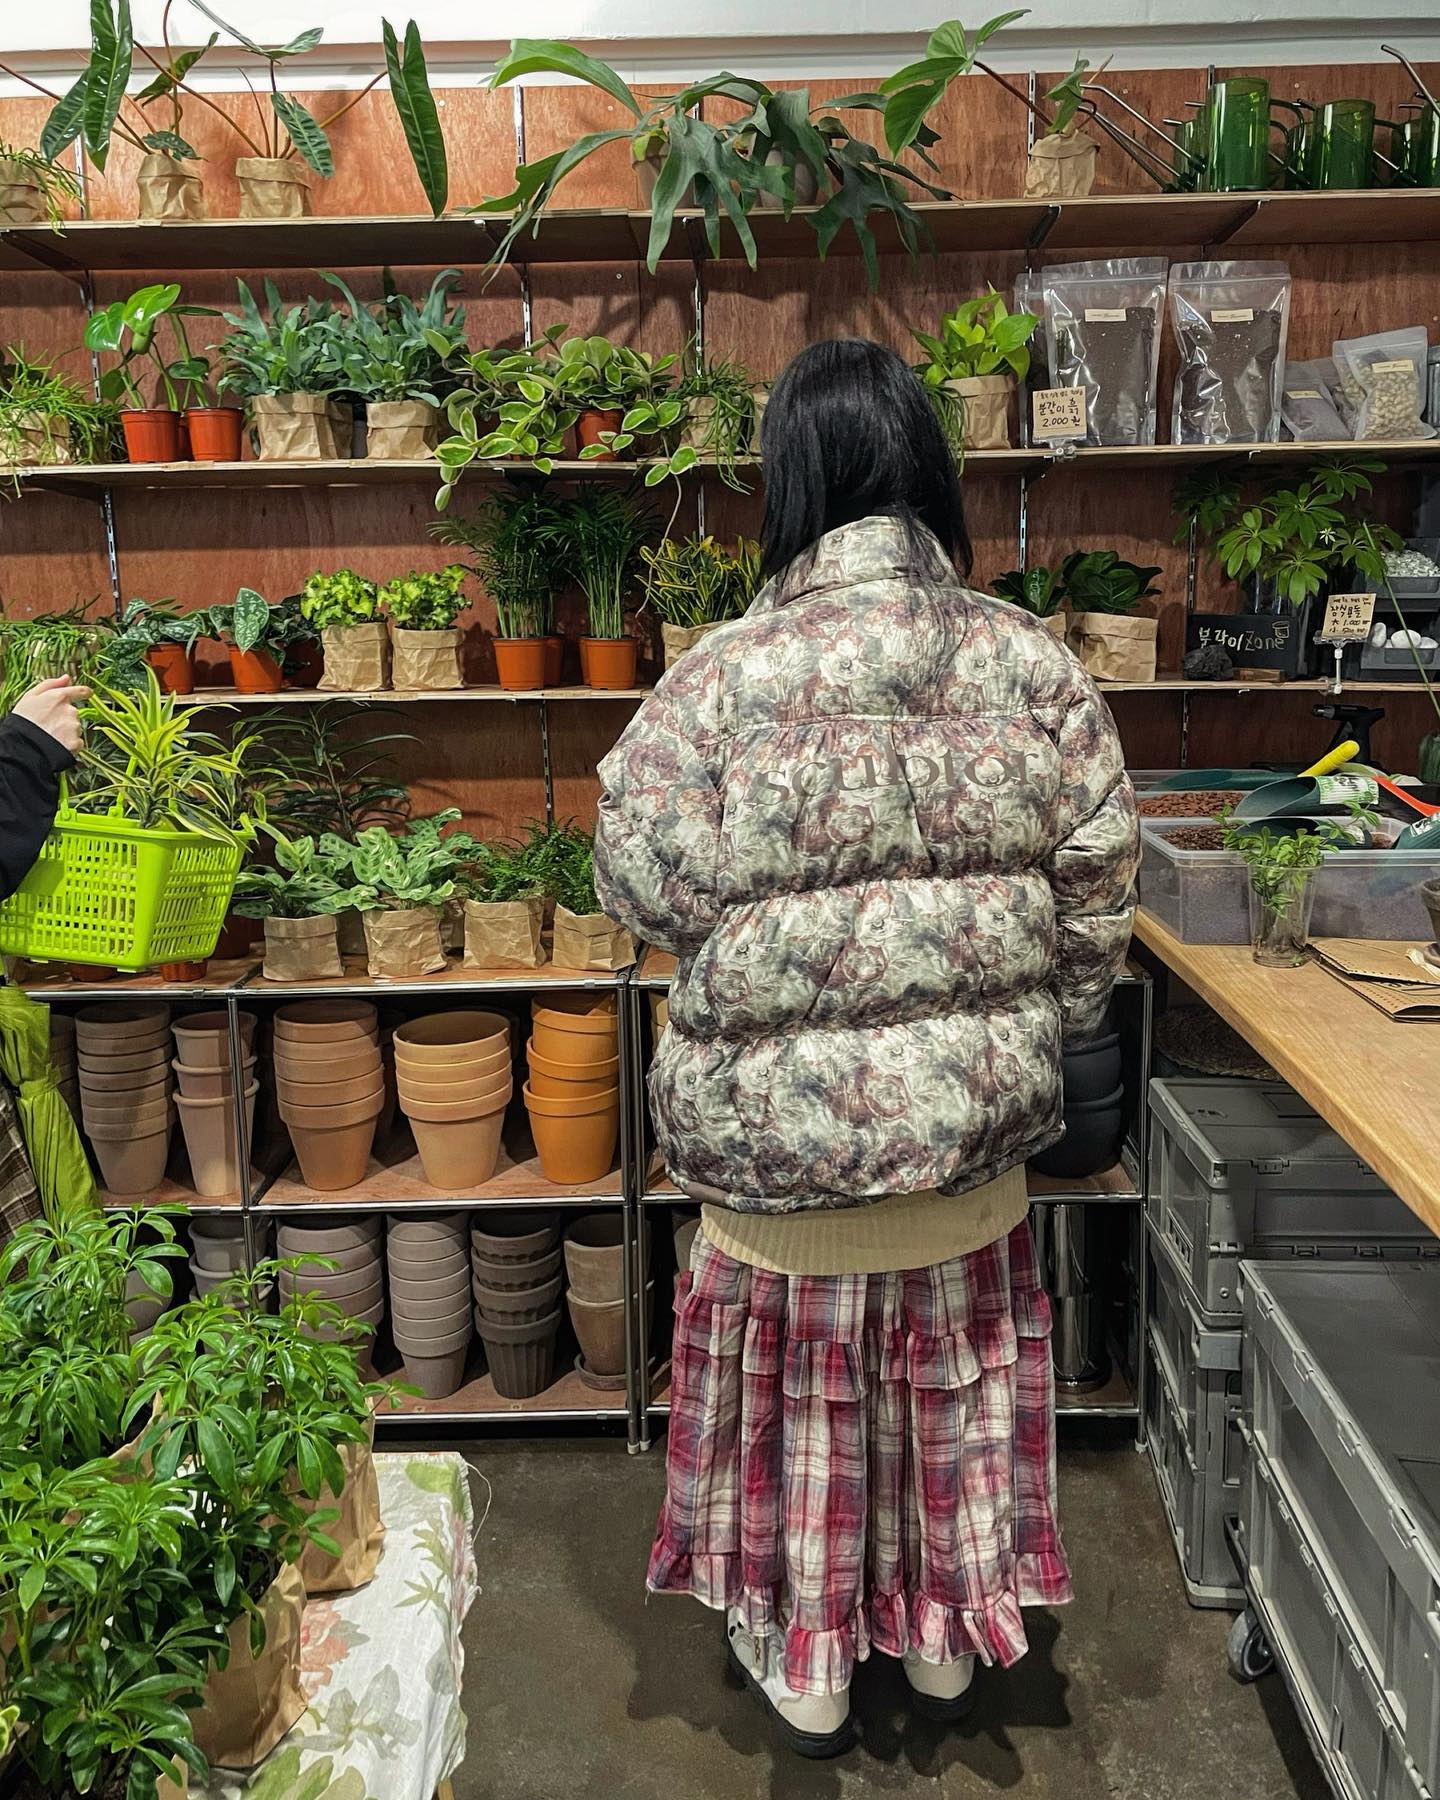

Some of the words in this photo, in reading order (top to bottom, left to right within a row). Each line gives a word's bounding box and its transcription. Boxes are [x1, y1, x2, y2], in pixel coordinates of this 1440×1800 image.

[1039, 401, 1065, 416] 분갈이
[1067, 397, 1079, 415] 흙
[1244, 630, 1285, 651] Zone
